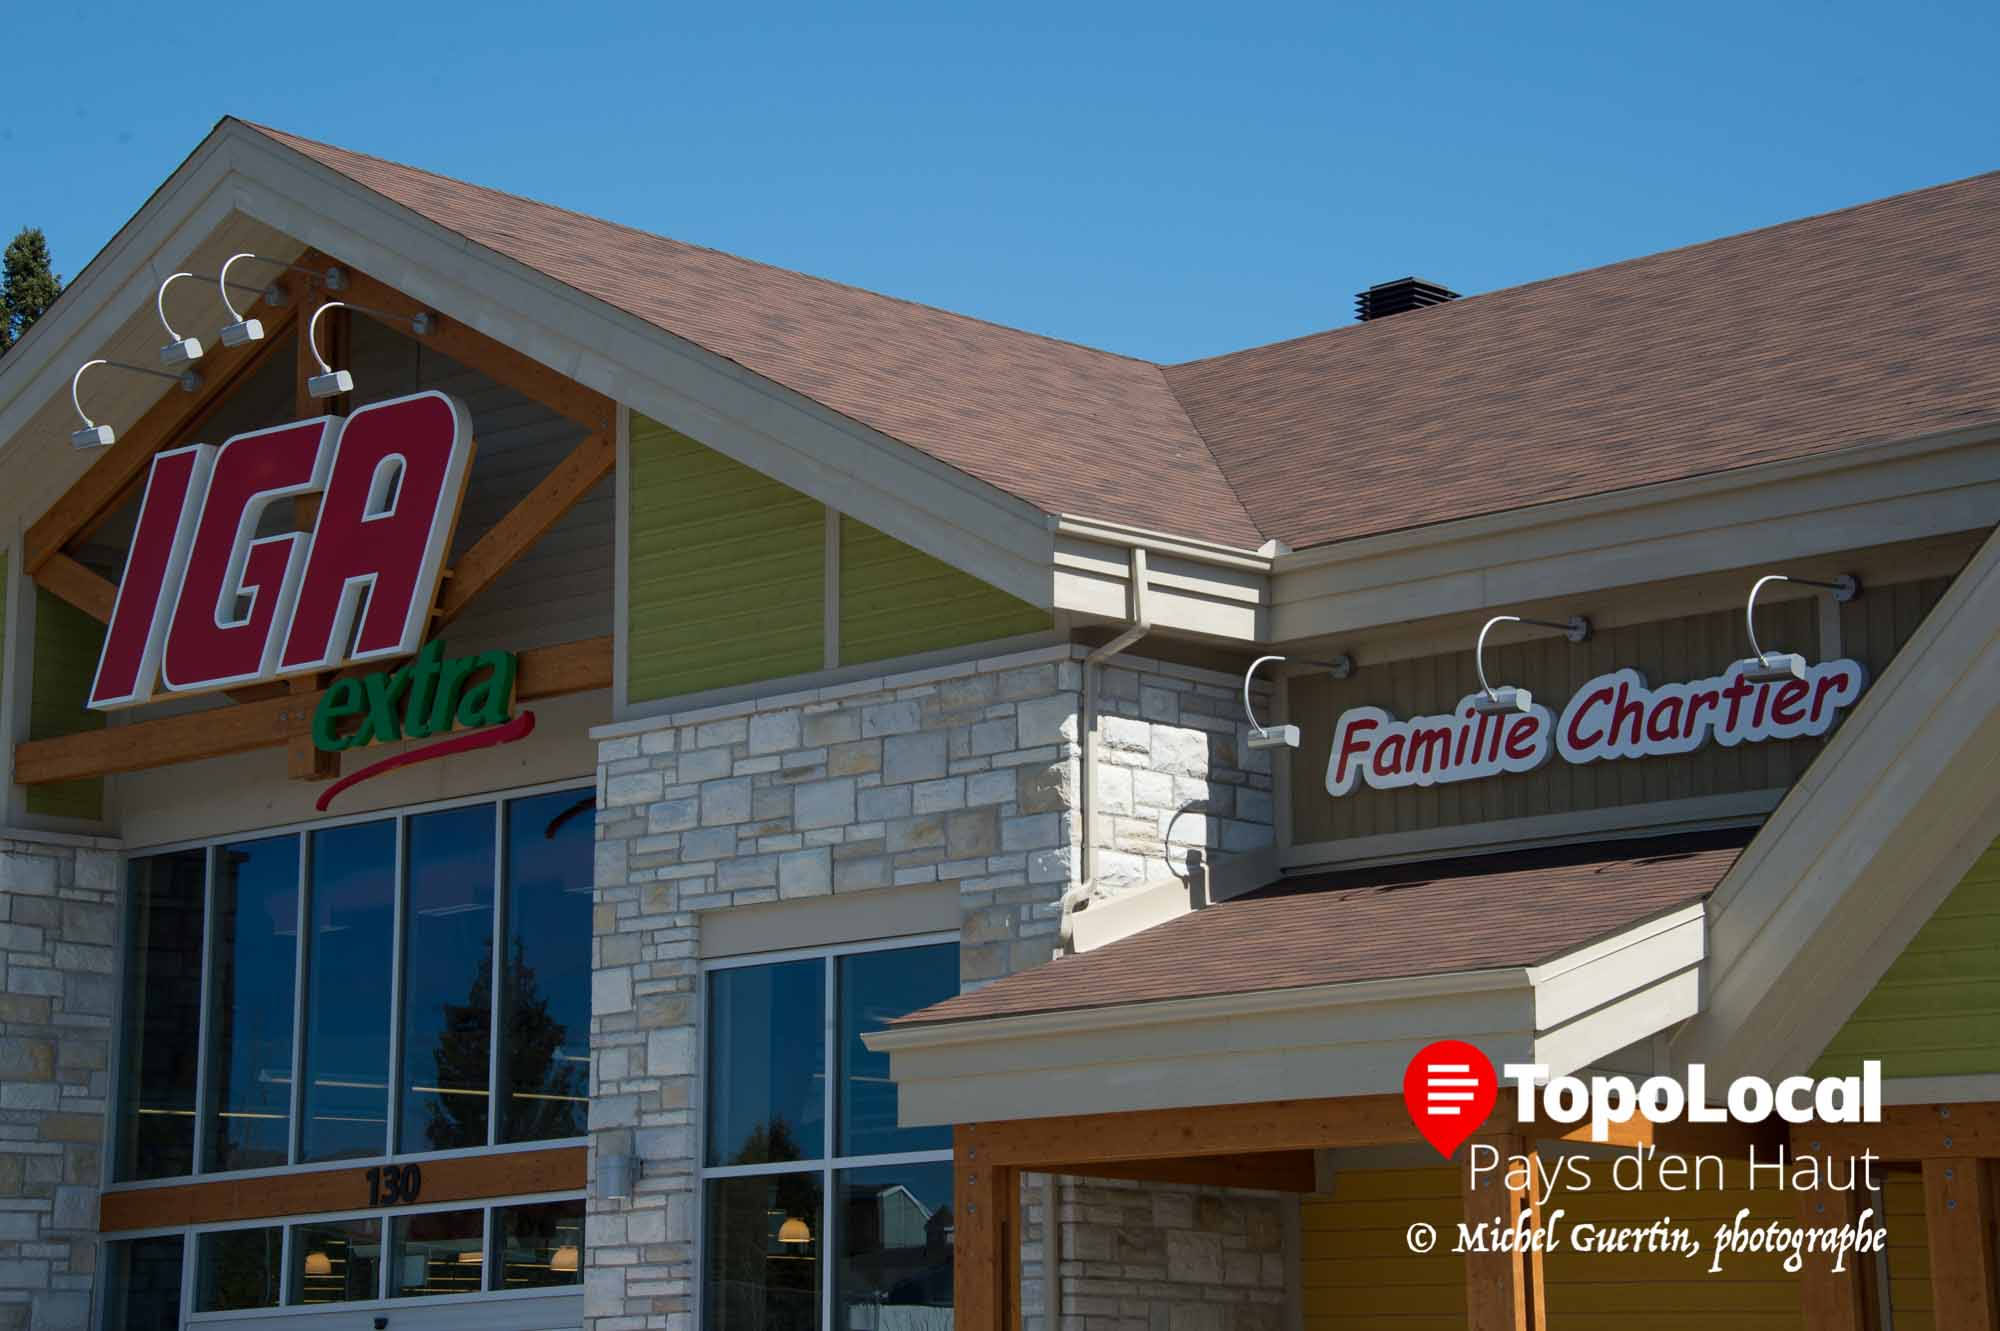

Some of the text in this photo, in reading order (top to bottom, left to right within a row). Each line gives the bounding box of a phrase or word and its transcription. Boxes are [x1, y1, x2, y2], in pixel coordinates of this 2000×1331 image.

[87, 390, 470, 711] IGA
[311, 638, 519, 752] extra
[1334, 670, 1850, 785] Famille Chartier
[367, 1164, 421, 1206] 130
